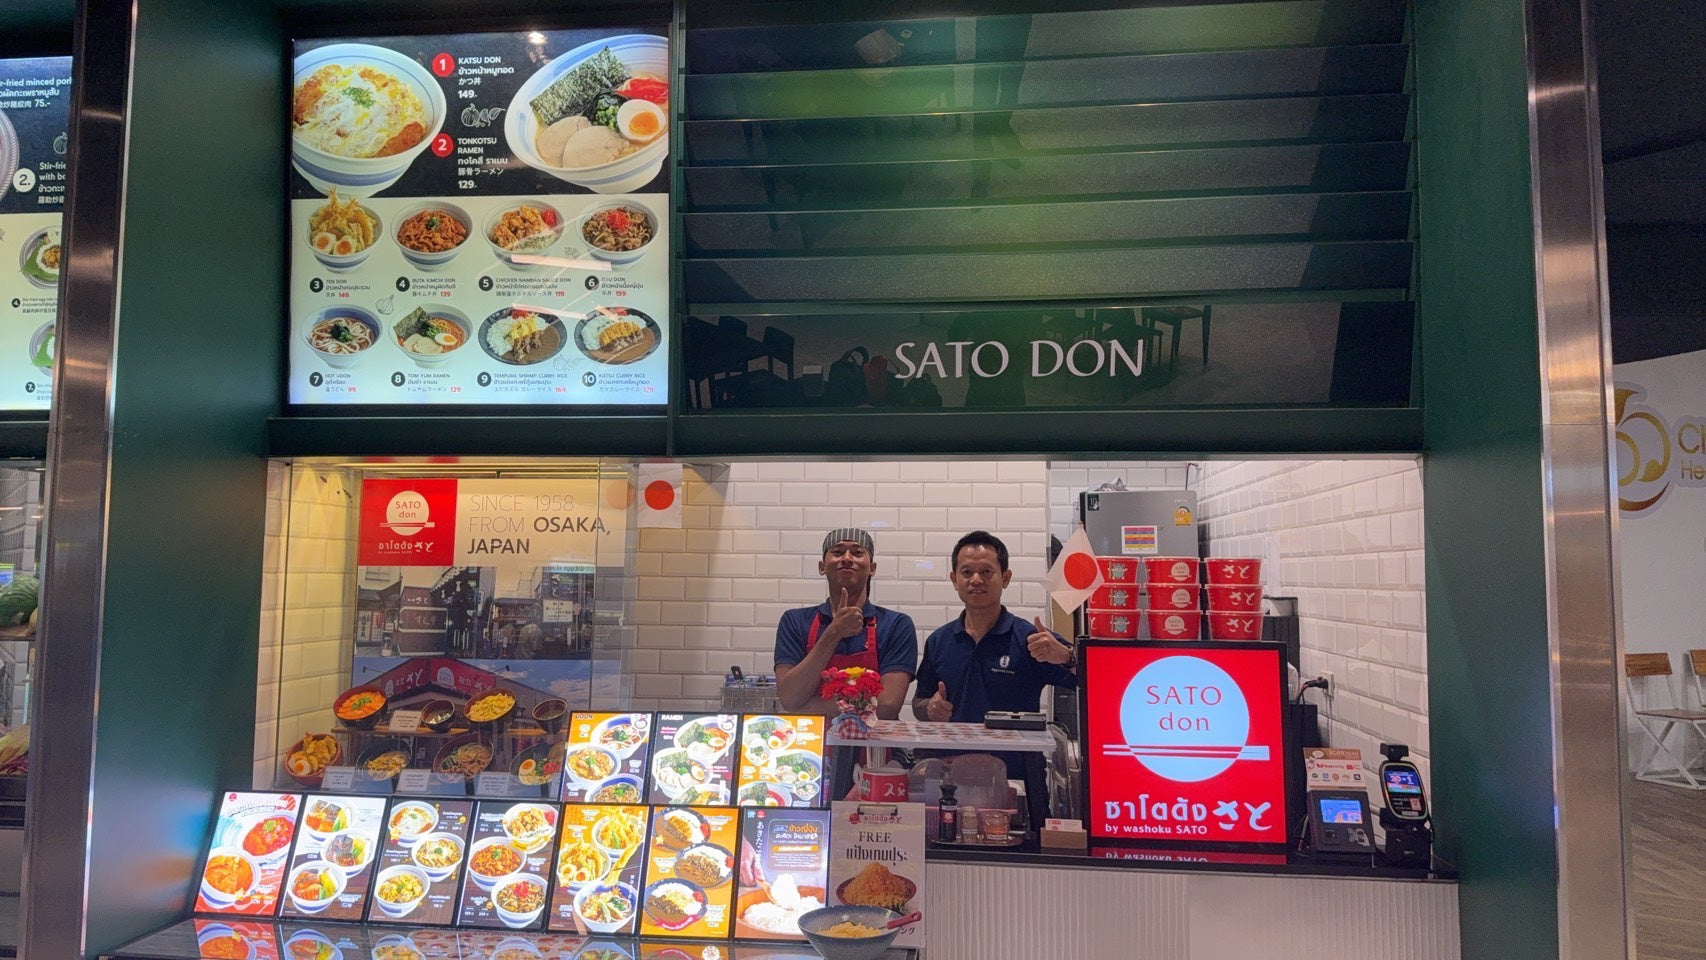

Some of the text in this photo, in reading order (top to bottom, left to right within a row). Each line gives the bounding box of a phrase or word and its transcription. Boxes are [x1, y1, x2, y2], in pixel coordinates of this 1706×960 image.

[439, 59, 446, 71] 1
[26, 78, 54, 86] minced
[35, 99, 50, 107] 75.-
[438, 138, 447, 151] 2
[458, 137, 497, 145] TONKOTSU
[19, 174, 30, 185] 2.
[313, 281, 320, 289] 3
[398, 280, 406, 288] 4
[482, 279, 490, 288] 5
[588, 278, 595, 287] 6
[895, 339, 1144, 379] SATO DON
[313, 376, 319, 384] 7
[394, 374, 402, 384] 8
[481, 374, 488, 384] 9
[582, 374, 595, 384] 10
[395, 501, 421, 509] SATO
[470, 494, 574, 512] SINCE 1958
[469, 516, 611, 535] FROM OSAKA,
[467, 538, 530, 554] JAPAN
[1222, 564, 1250, 579] さと
[1228, 591, 1255, 606] さと
[1226, 618, 1253, 633] さと
[1146, 685, 1222, 706] SATO
[1159, 712, 1210, 731] don
[1104, 793, 1207, 821] ซาโตดัง
[1213, 800, 1273, 831] さと
[1105, 823, 1208, 835] by washoku SATO
[859, 831, 892, 843] FREE
[846, 845, 908, 866] แป้งเทมปุระ
